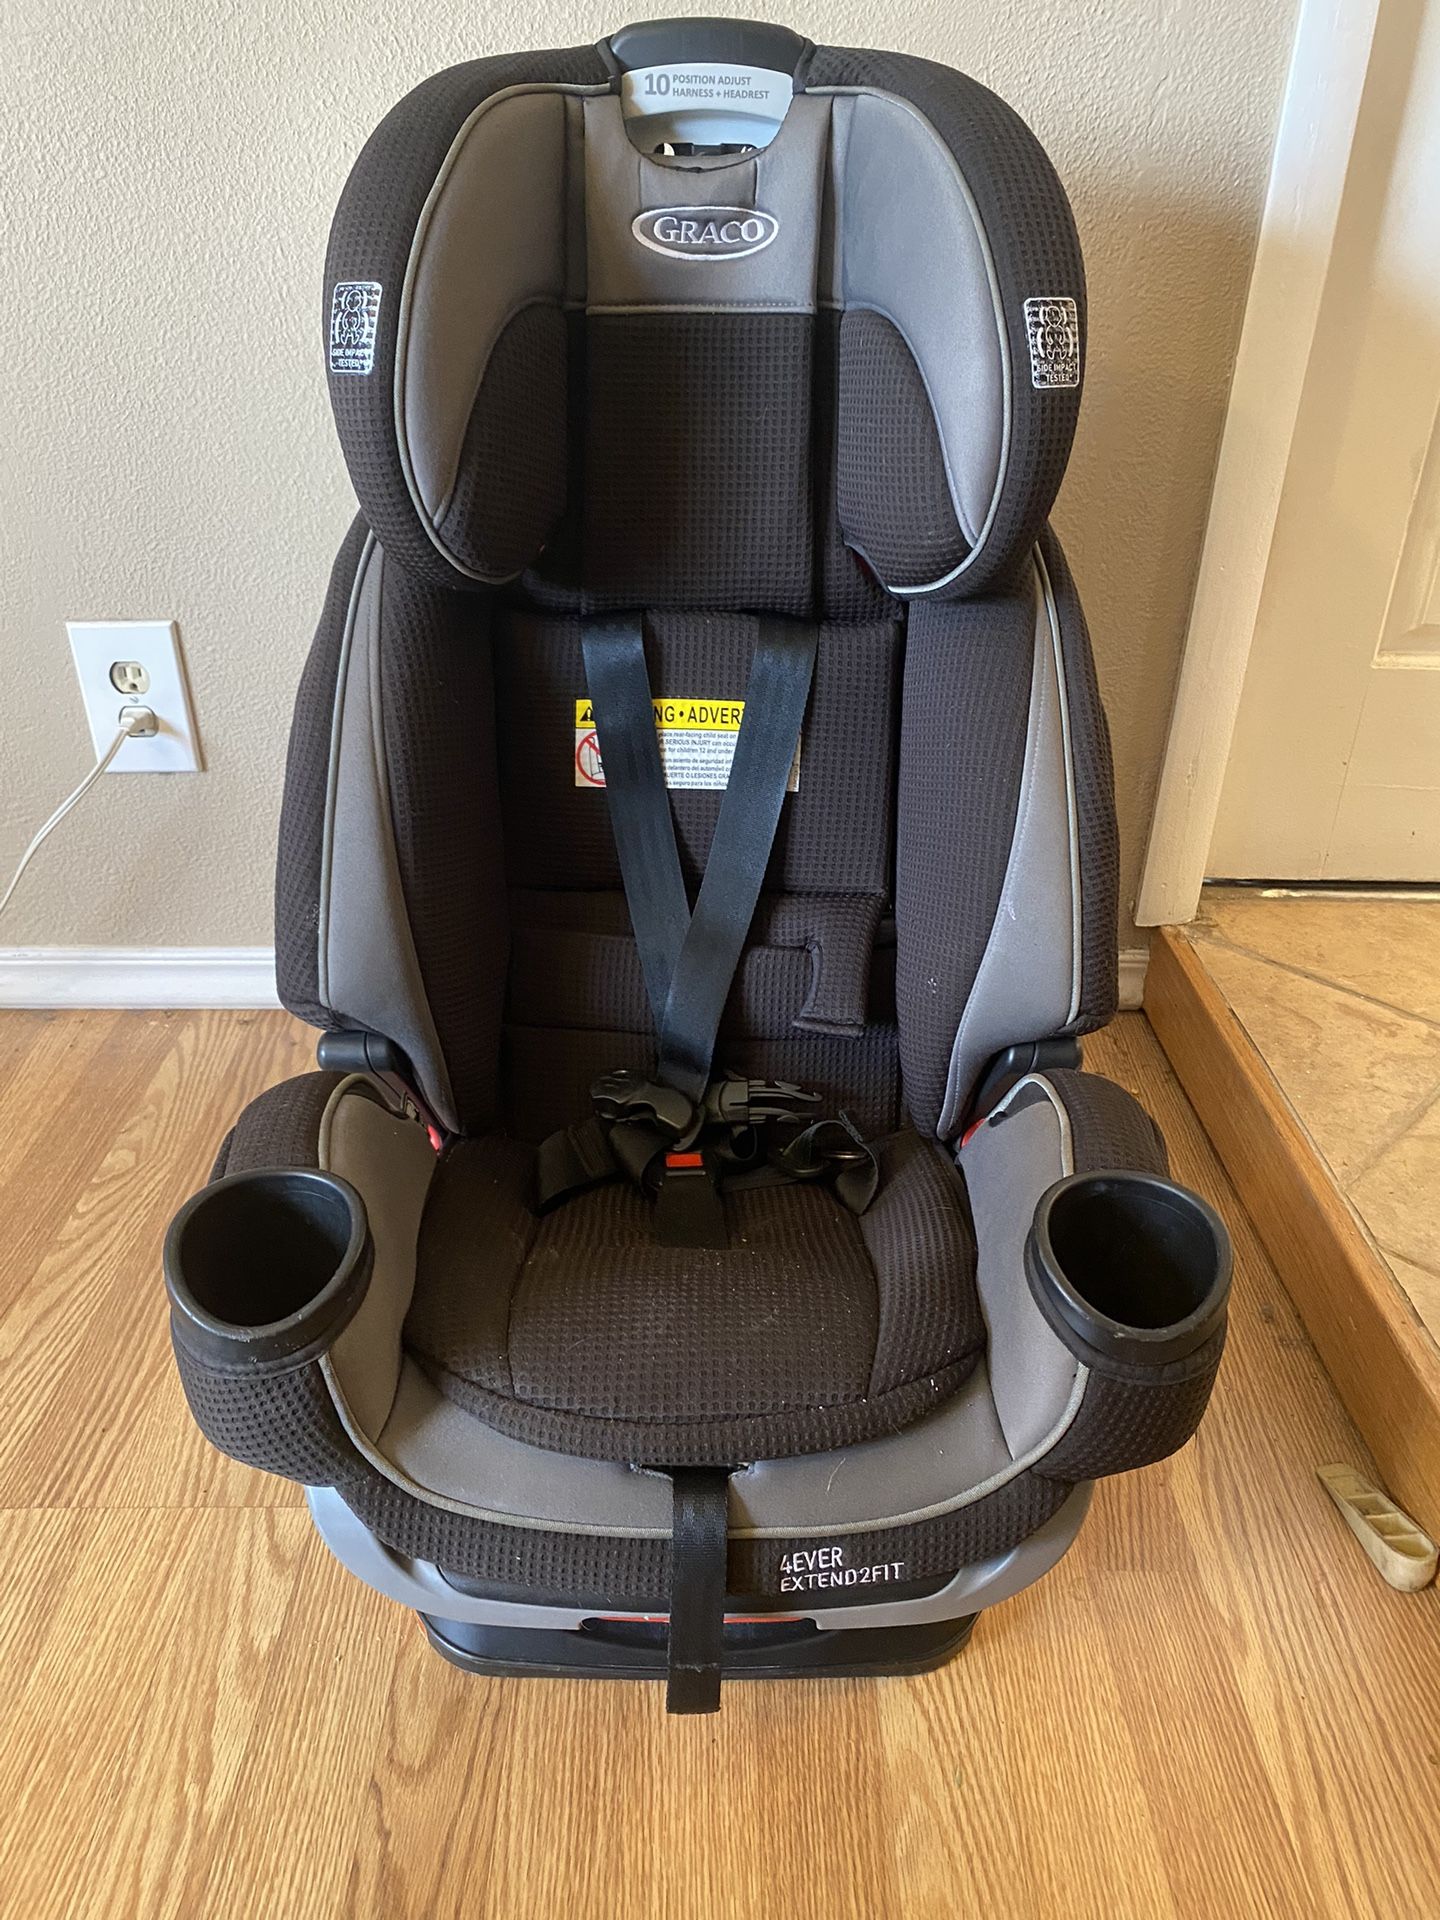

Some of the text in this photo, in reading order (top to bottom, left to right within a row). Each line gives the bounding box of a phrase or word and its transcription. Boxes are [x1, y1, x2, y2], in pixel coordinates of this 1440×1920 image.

[645, 73, 751, 96] 10 POSITION ADJUST
[672, 88, 714, 98] HARNESS
[723, 89, 770, 100] HEADREST
[653, 216, 765, 244] GRACO
[1036, 363, 1076, 372] SIDE IMPACT
[653, 705, 743, 725] NG ADVER
[665, 738, 690, 746] SERIOUS
[780, 1546, 843, 1574] 4EVER
[780, 1562, 905, 1593] EXTEND2FIT
